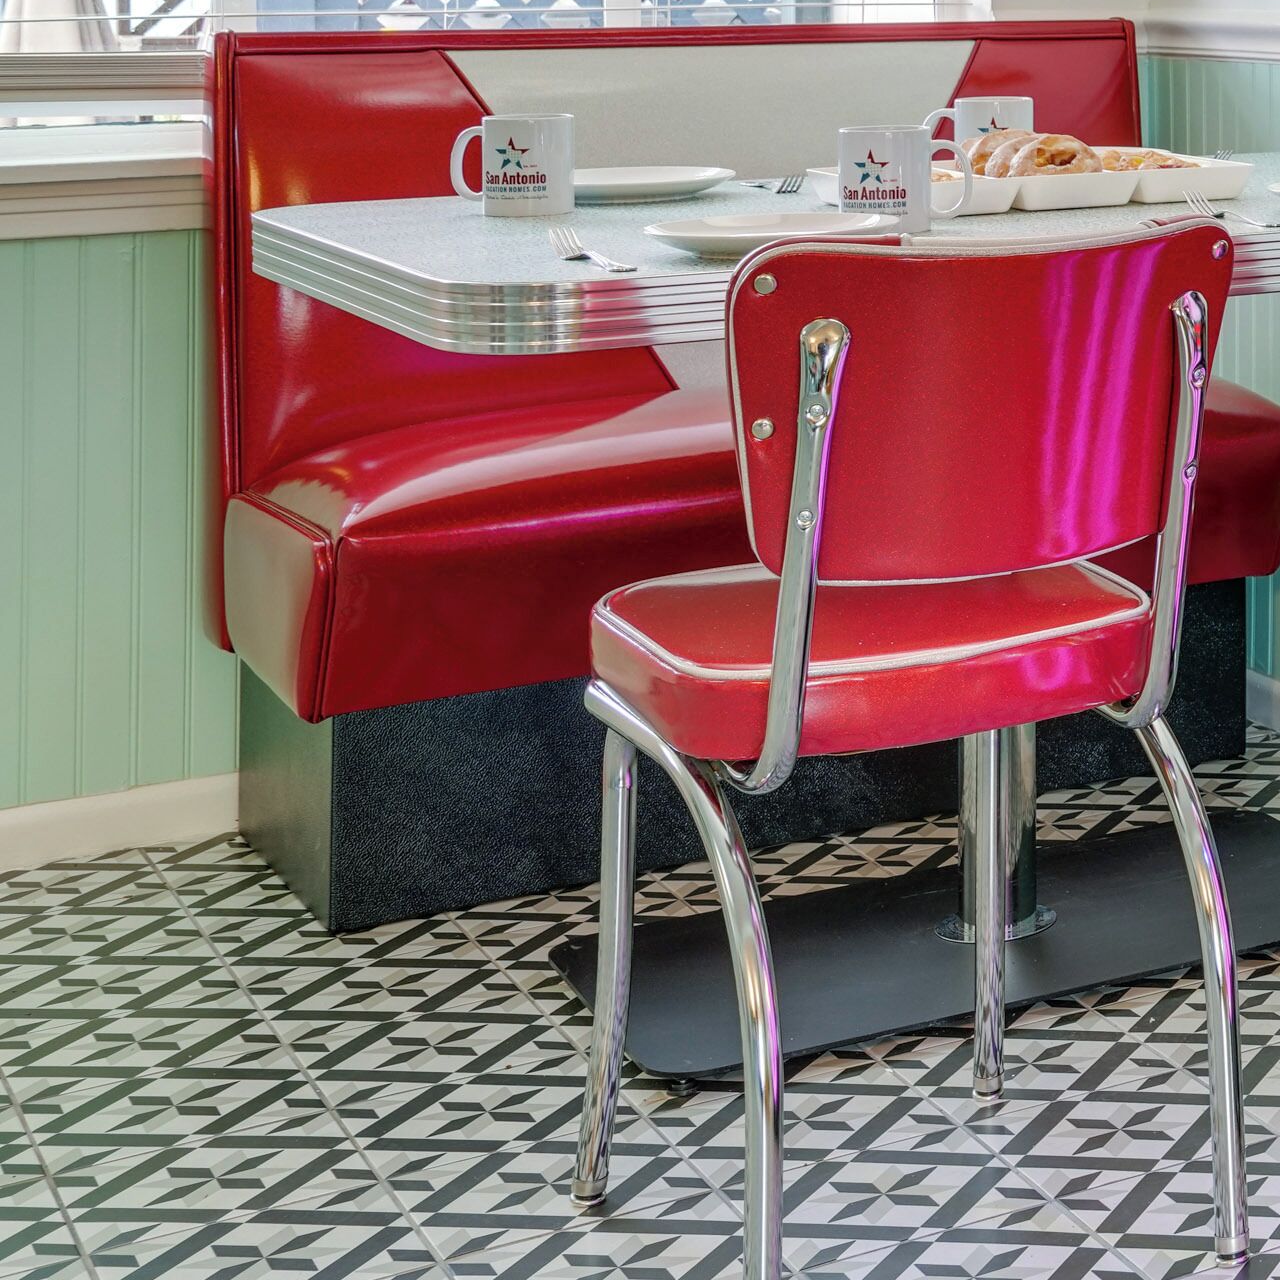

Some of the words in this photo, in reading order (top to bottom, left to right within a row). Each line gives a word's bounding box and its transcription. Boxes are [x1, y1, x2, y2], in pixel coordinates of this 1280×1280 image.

[486, 171, 499, 184] San
[502, 172, 546, 184] Antonio
[843, 185, 859, 200] San
[861, 185, 906, 200] Antonio
